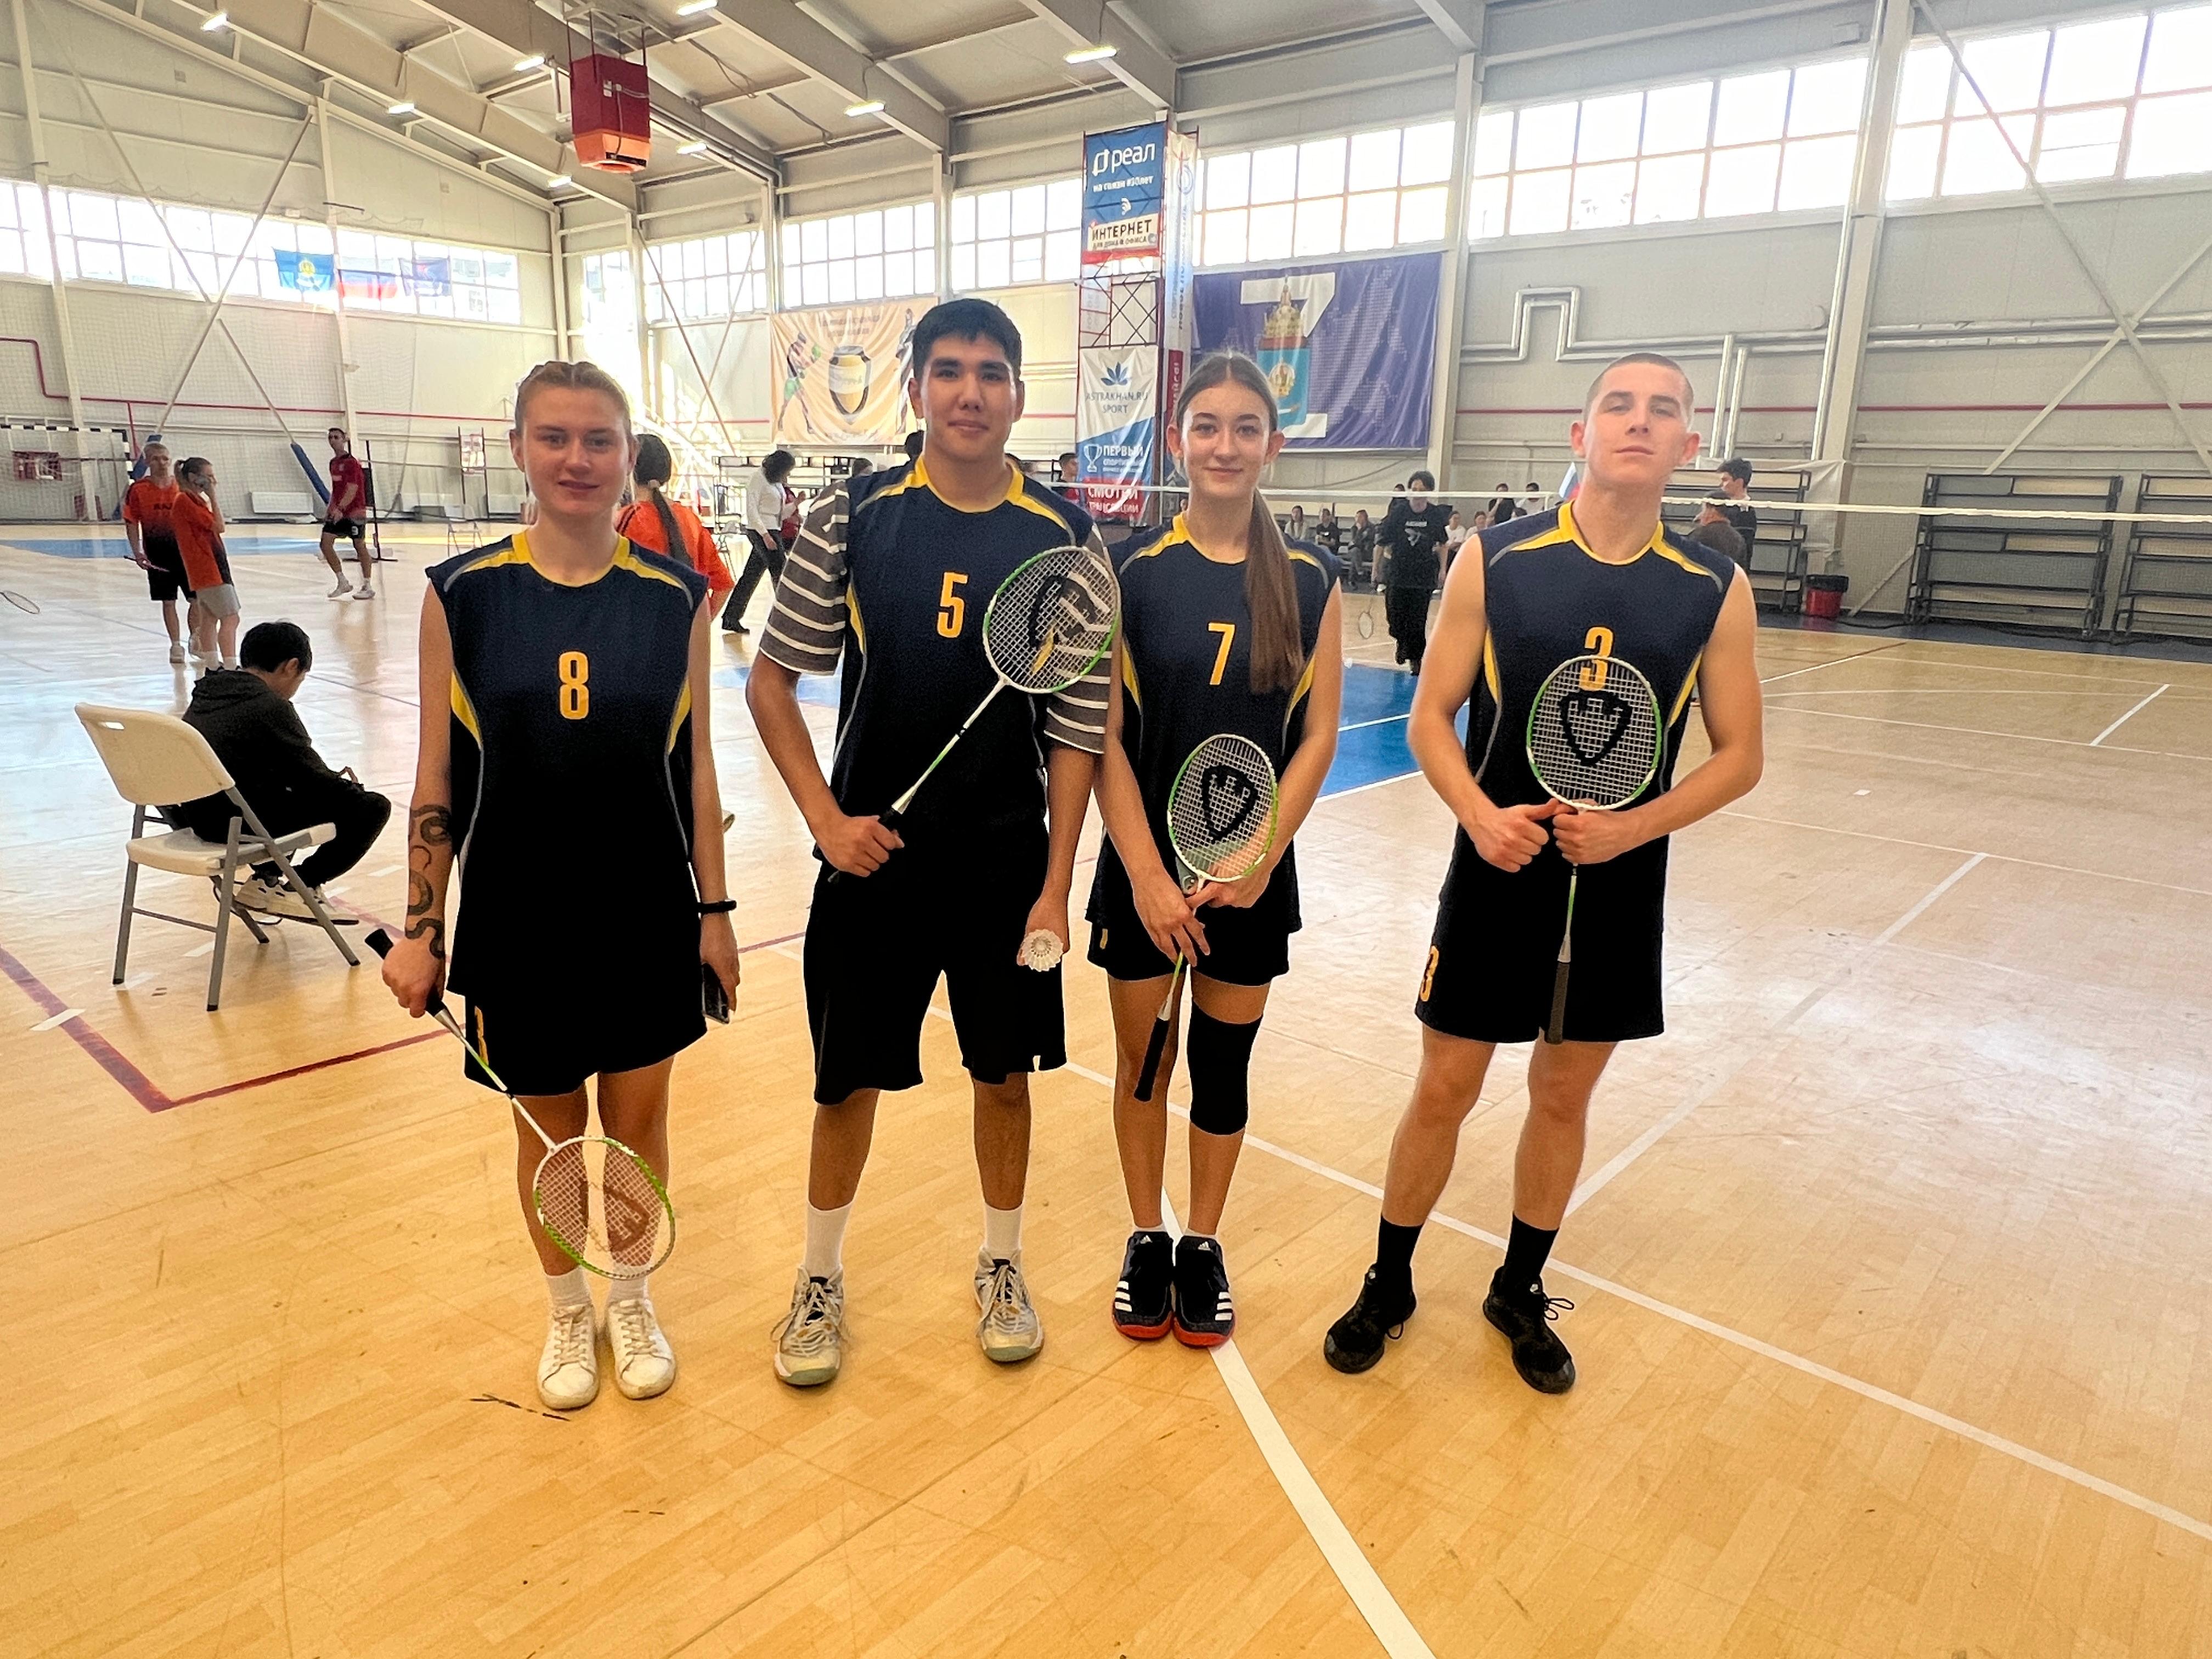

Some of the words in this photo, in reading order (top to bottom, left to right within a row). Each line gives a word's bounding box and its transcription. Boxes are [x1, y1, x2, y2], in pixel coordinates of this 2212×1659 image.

[1092, 219, 1152, 241] ИНТЕРНЕТ
[1103, 404, 1128, 414] SPORT
[936, 571, 968, 638] 5
[1208, 622, 1236, 685] 7
[1578, 626, 1614, 691] 3
[558, 651, 590, 721] 8
